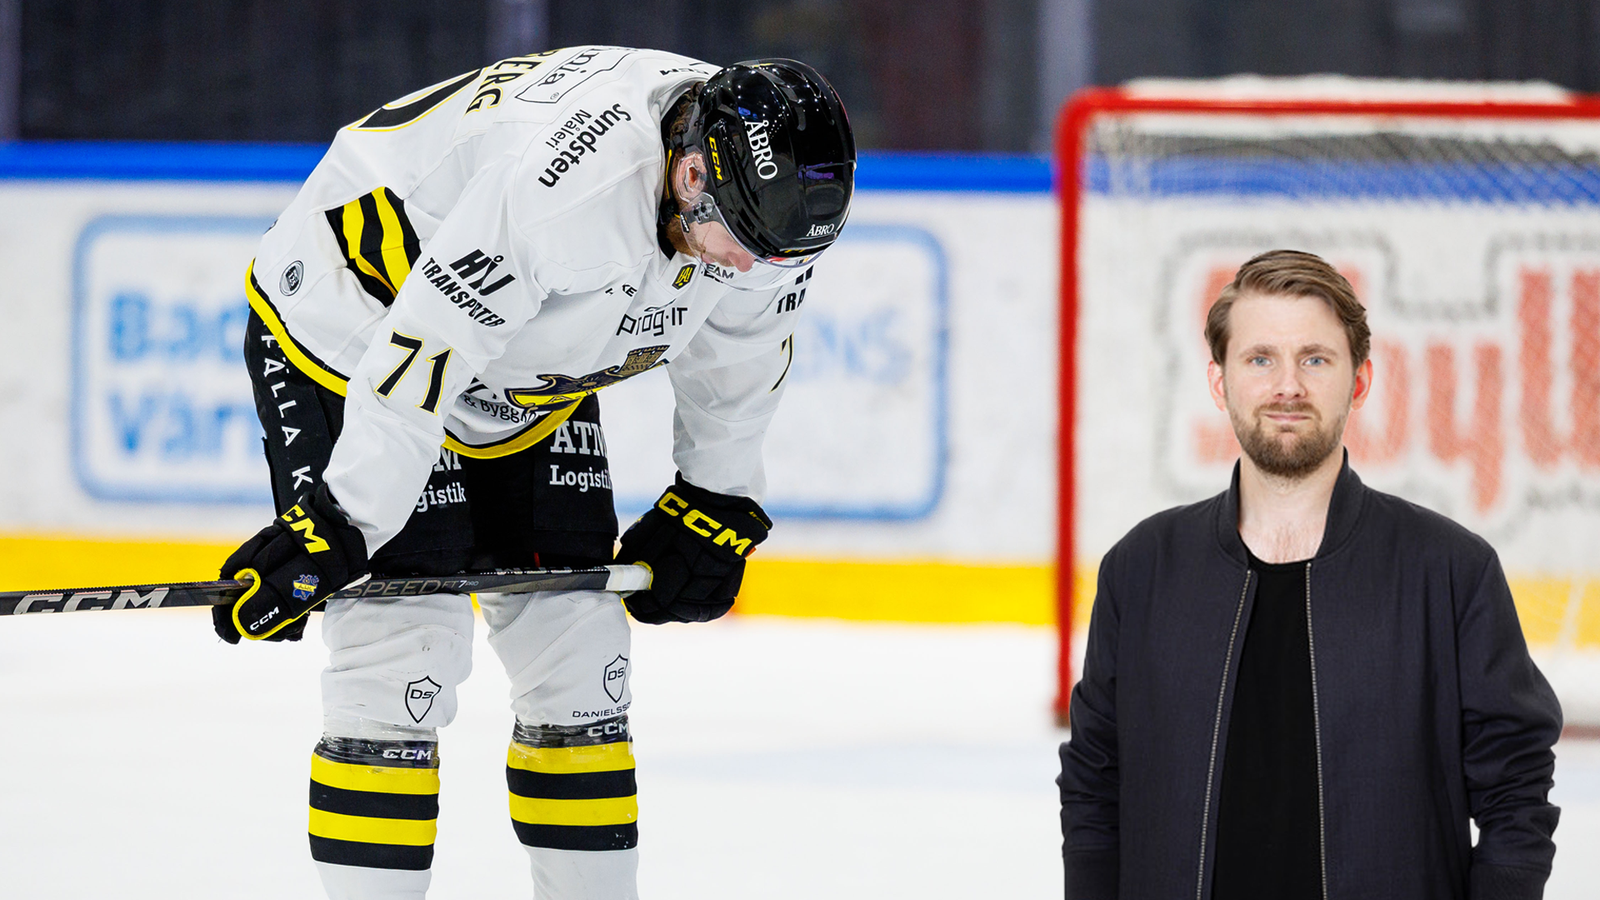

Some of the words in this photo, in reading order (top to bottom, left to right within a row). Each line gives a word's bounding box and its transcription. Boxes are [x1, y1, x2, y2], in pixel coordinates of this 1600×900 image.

[464, 51, 556, 115] ERG
[537, 103, 632, 188] Sundsten
[545, 109, 593, 151] Måleri
[708, 136, 723, 181] CCM
[744, 119, 778, 180] ÅBRO
[806, 223, 835, 238] ÅBRO
[706, 262, 734, 279] EAM
[374, 328, 453, 416] 71
[416, 482, 466, 513] gistik
[281, 504, 331, 554] CM
[657, 491, 752, 556] CCM
[13, 587, 169, 615] CCM
[249, 606, 280, 631] CCM
[608, 667, 625, 681] DS
[409, 688, 434, 700] DS
[588, 722, 629, 737] CCM
[382, 748, 431, 760] CCM
